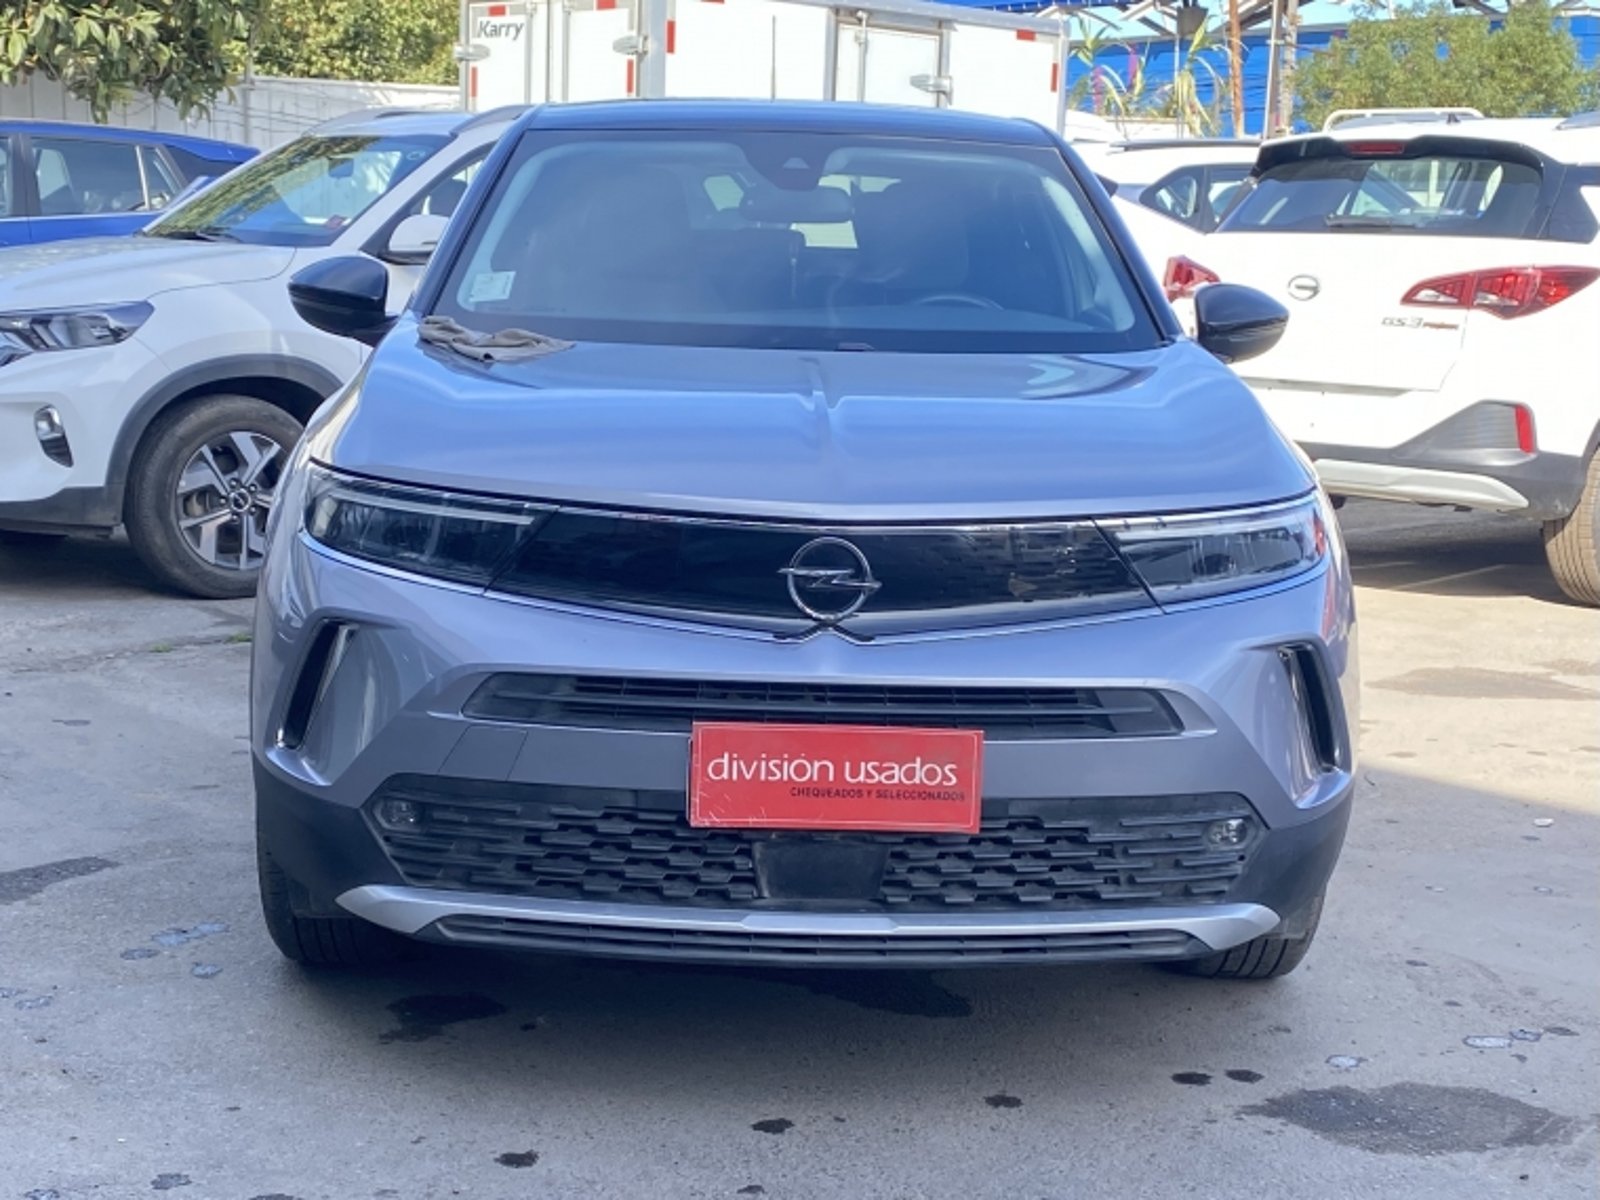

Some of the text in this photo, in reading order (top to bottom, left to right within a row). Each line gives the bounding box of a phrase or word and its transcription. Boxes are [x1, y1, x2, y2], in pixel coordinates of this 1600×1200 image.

[477, 20, 524, 41] Karry
[707, 752, 957, 786] división usados
[790, 786, 965, 802] CHEQUEADOS Y SELECCIONADOS
